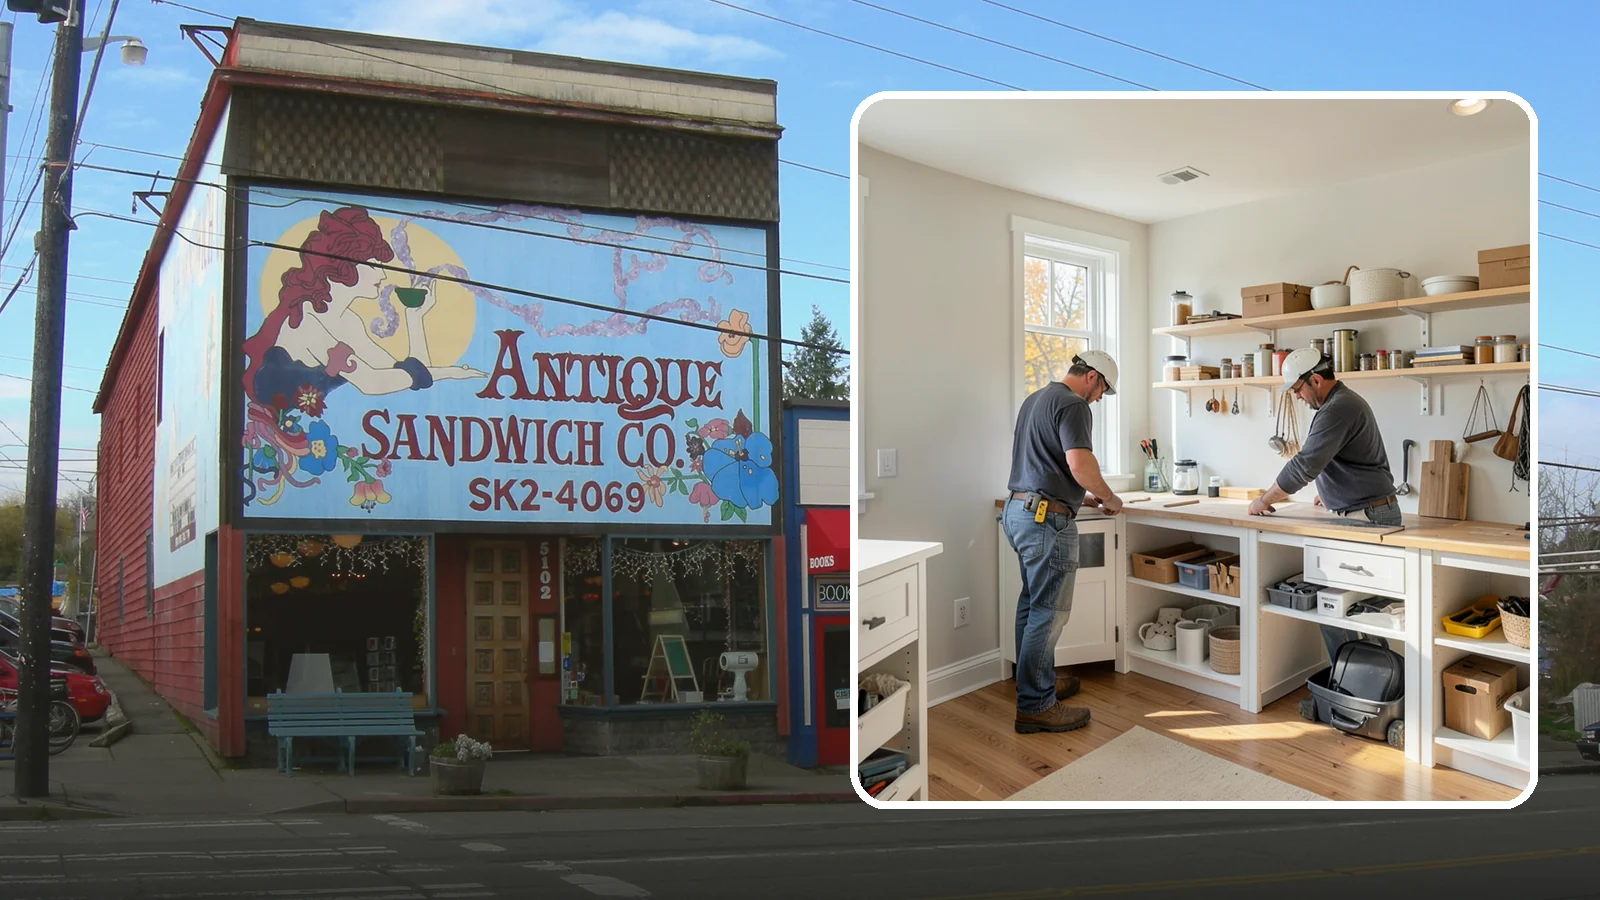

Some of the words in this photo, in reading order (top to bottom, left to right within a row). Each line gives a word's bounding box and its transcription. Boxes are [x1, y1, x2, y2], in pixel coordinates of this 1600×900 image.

[476, 329, 723, 420] ANTIQUE
[361, 408, 604, 468] SANDWICH
[617, 422, 685, 469] CO.
[468, 477, 646, 513] SK2-4069
[539, 541, 552, 600] 5102
[809, 555, 834, 568] BOOKS
